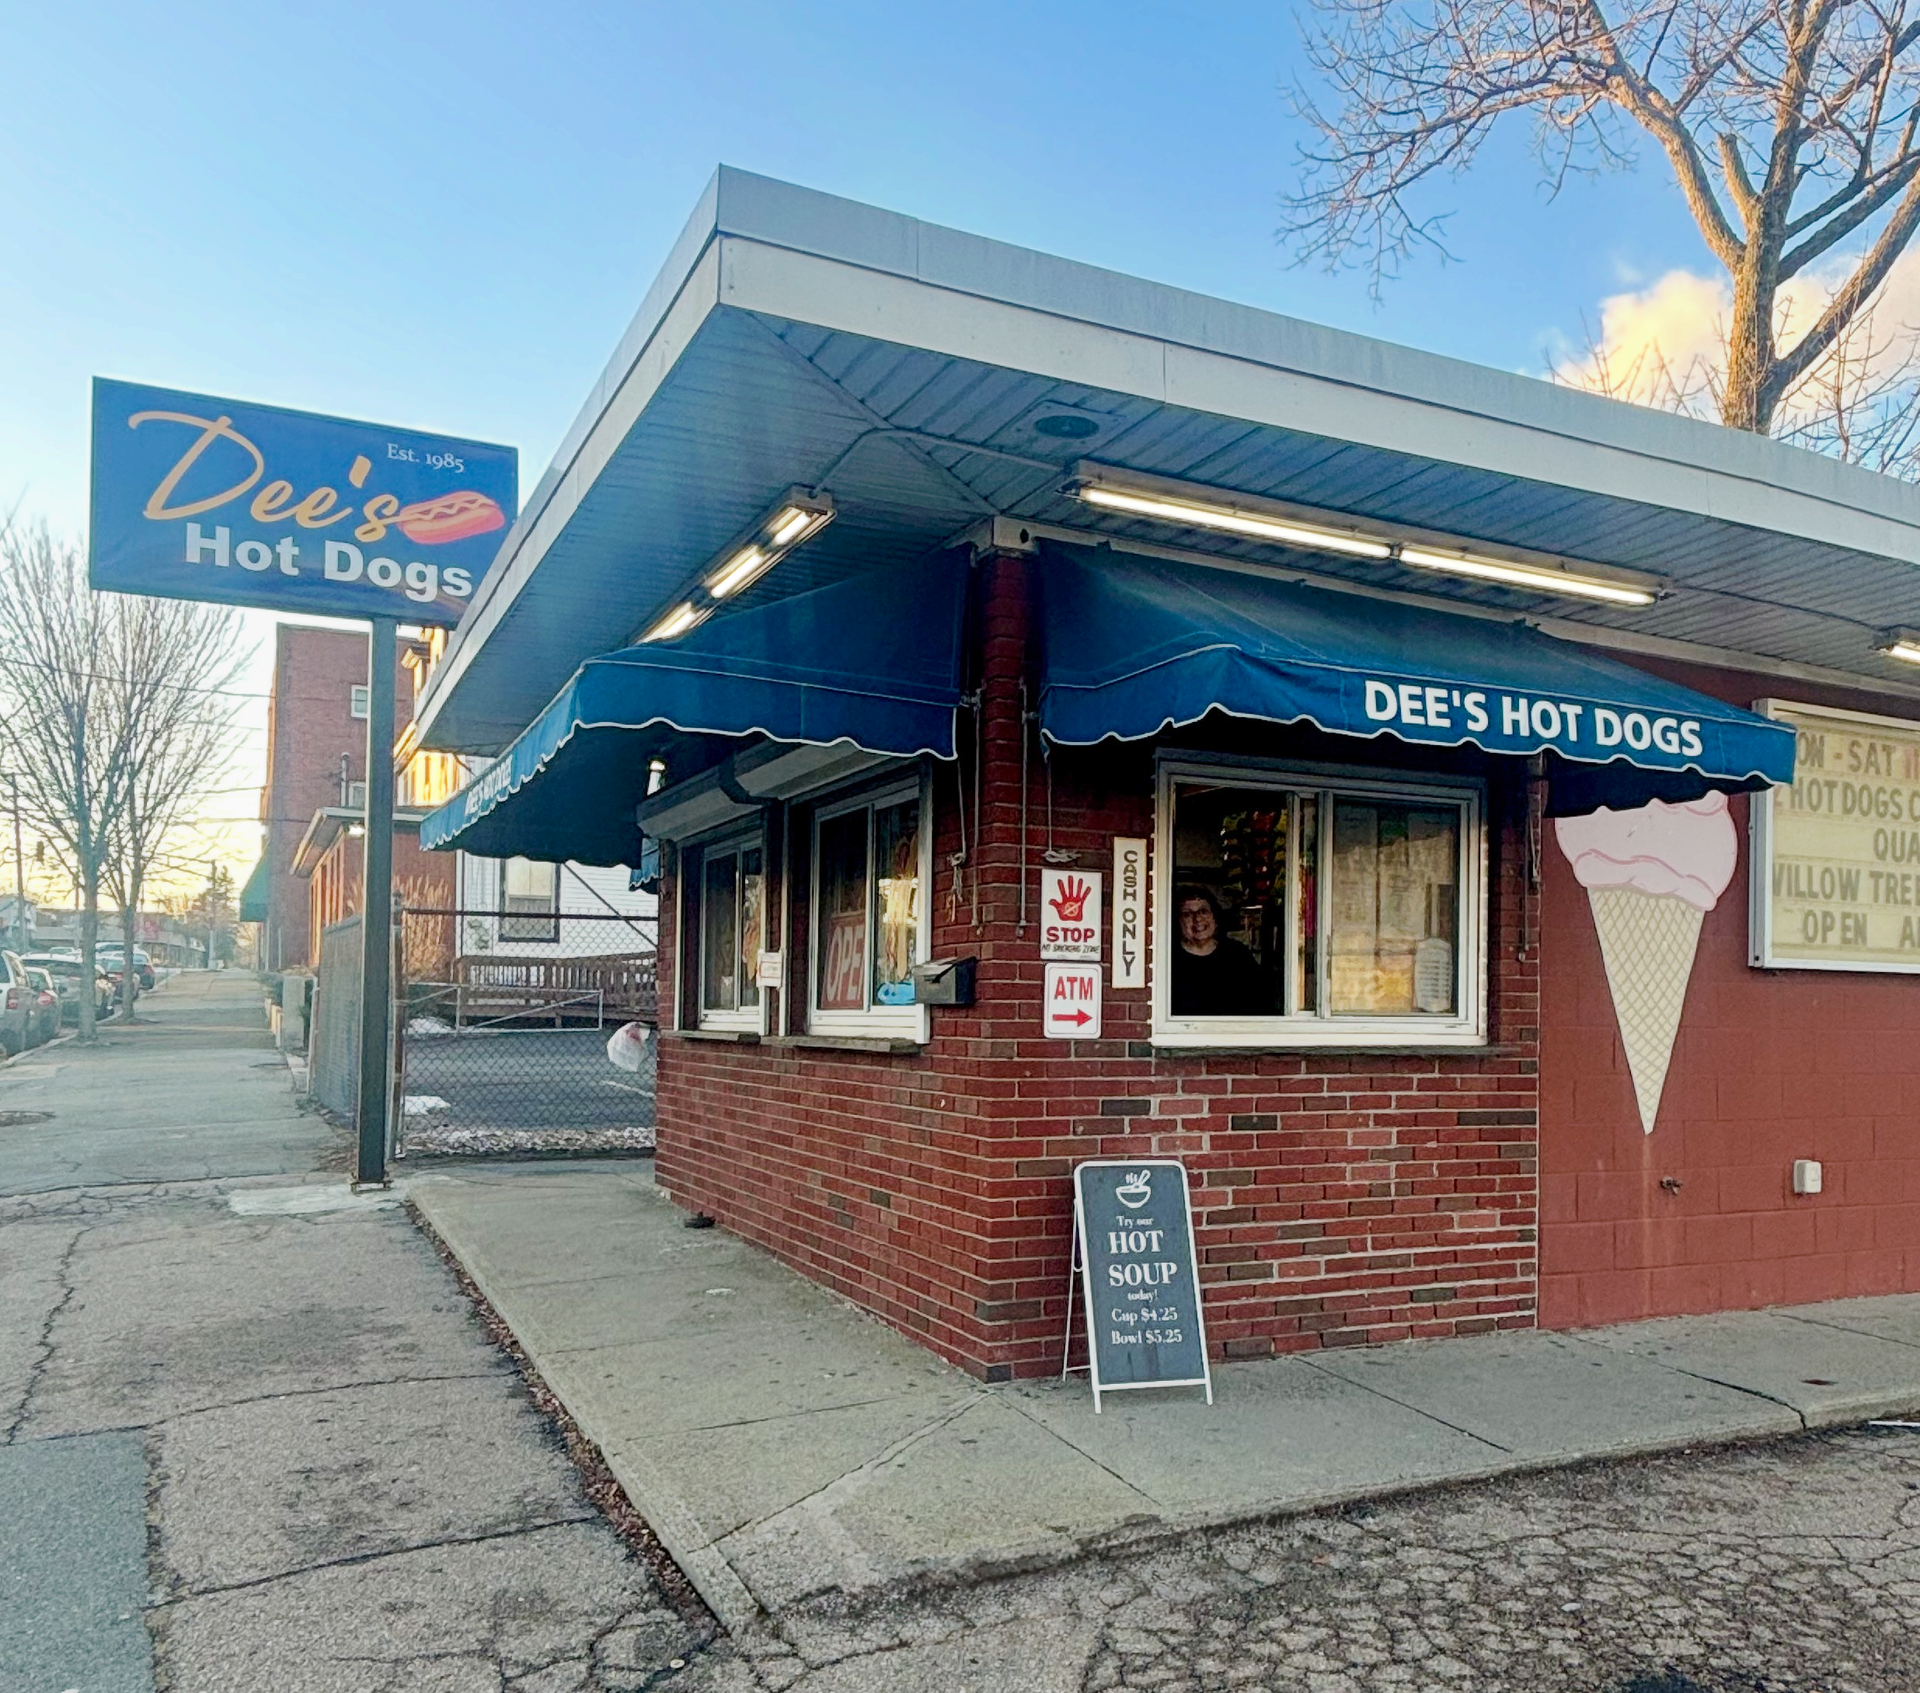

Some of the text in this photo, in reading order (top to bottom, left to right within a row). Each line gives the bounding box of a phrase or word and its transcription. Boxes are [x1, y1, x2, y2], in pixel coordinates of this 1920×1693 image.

[386, 443, 465, 473] Est. 1985
[128, 410, 408, 543] Dee's
[186, 522, 473, 602] Hot Dogs
[1365, 680, 1703, 757] DEE'S HOT DOGS
[1798, 732, 1825, 768] ON
[1848, 739, 1896, 777] SAT
[1122, 850, 1138, 977] CASH ONLY
[1046, 926, 1096, 943] STOP
[1802, 909, 1868, 946] OPEN
[826, 924, 865, 1002] OPE
[1054, 976, 1093, 1001] ATM
[1116, 1215, 1154, 1229] Try our
[1108, 1230, 1164, 1254] HOT
[1108, 1262, 1178, 1287] SOUP
[1127, 1288, 1158, 1302] today!
[1111, 1306, 1178, 1326] Cup $4.25
[1111, 1329, 1183, 1345] Bowl $5.25
